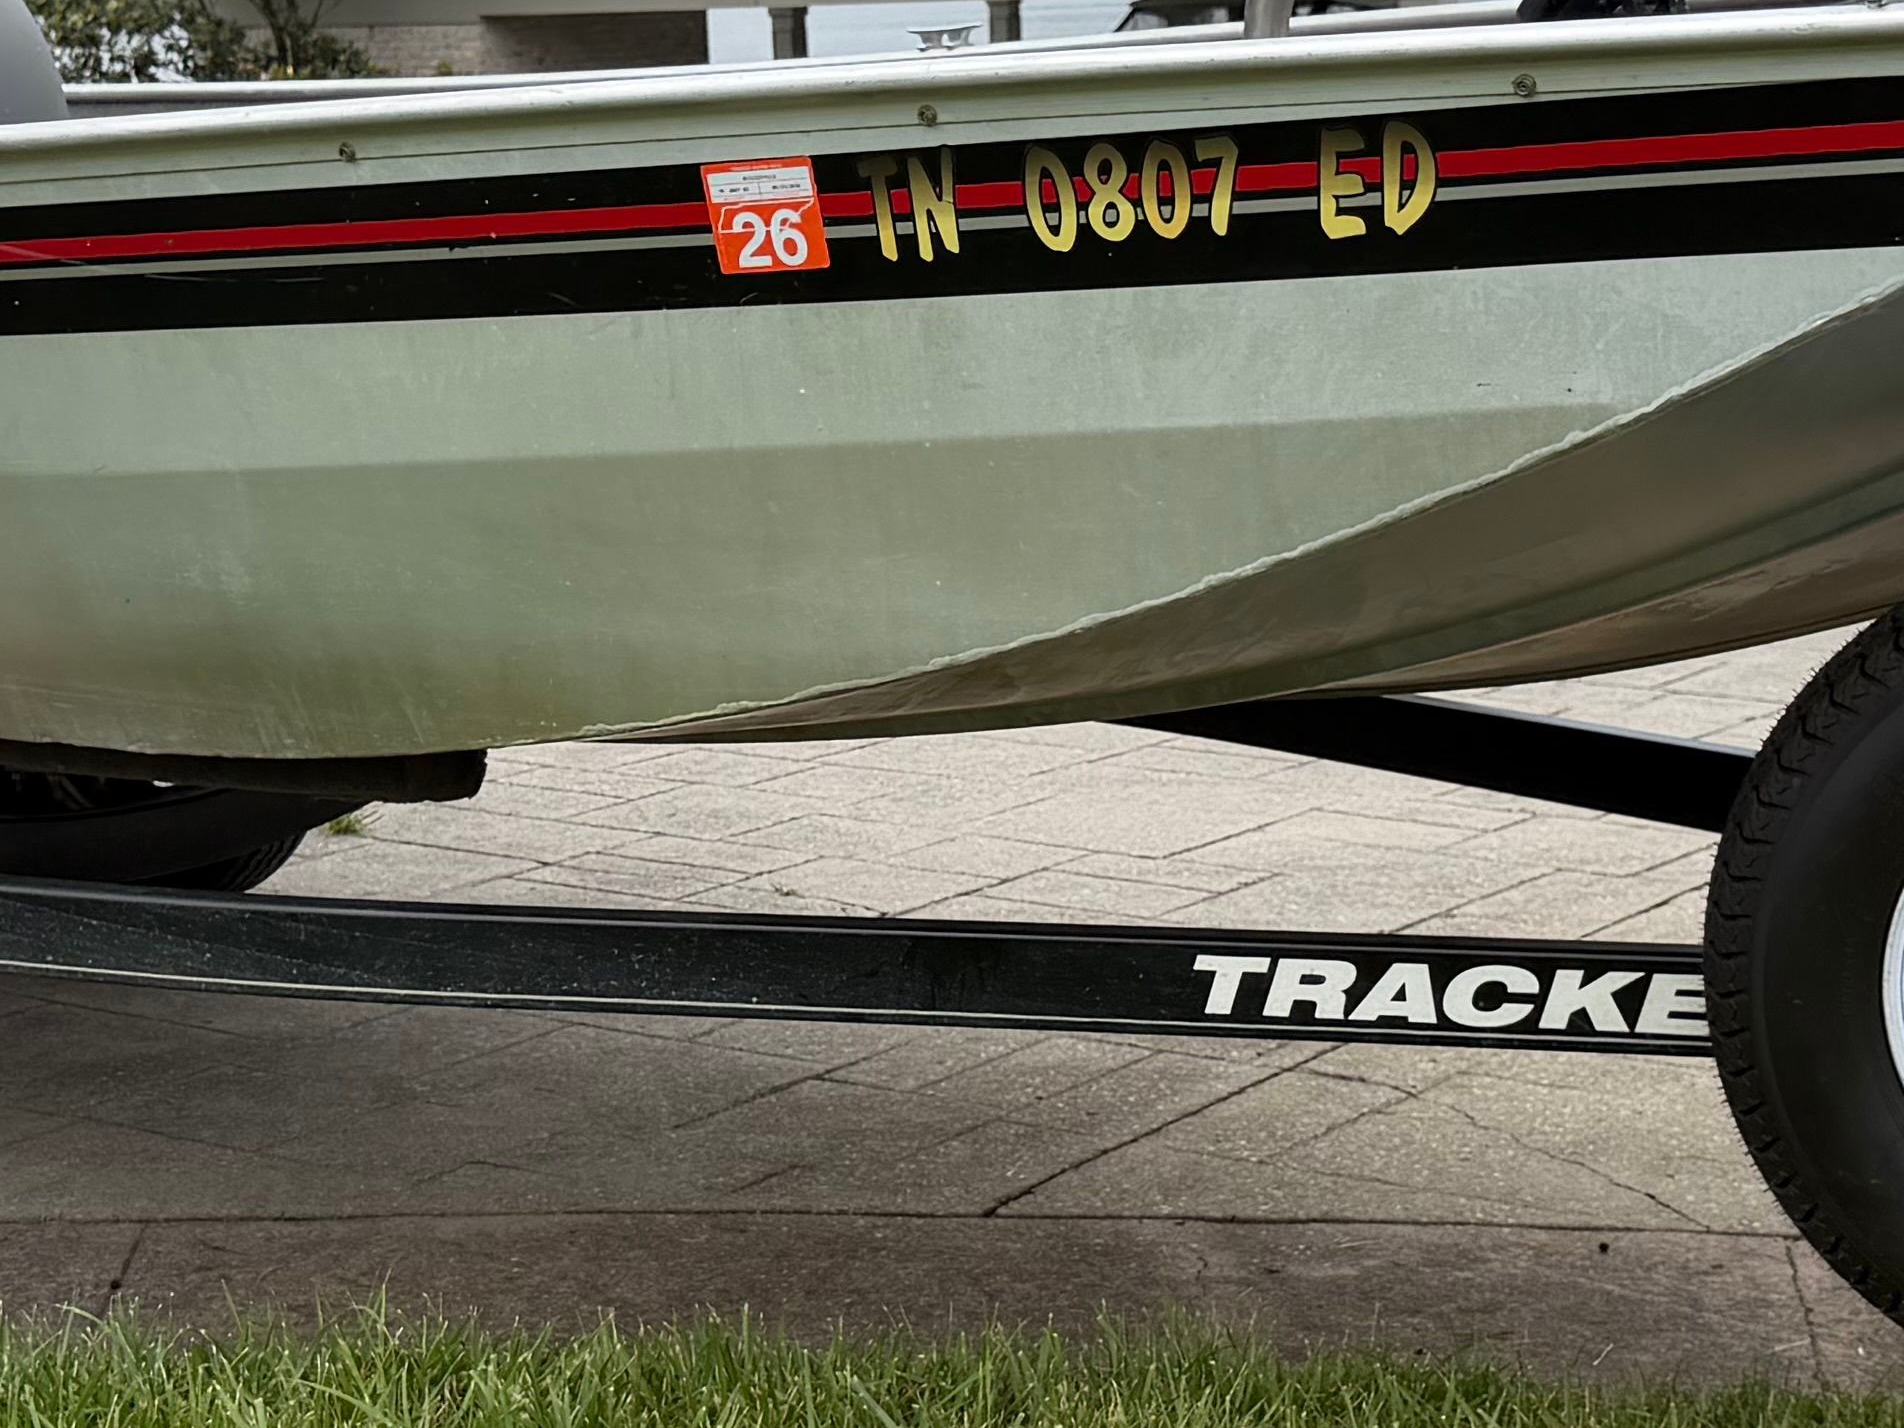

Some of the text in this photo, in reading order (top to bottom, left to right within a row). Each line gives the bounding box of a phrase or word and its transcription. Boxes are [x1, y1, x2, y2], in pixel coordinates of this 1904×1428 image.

[732, 208, 809, 269] 26
[856, 121, 1437, 262] TN 0807 ED
